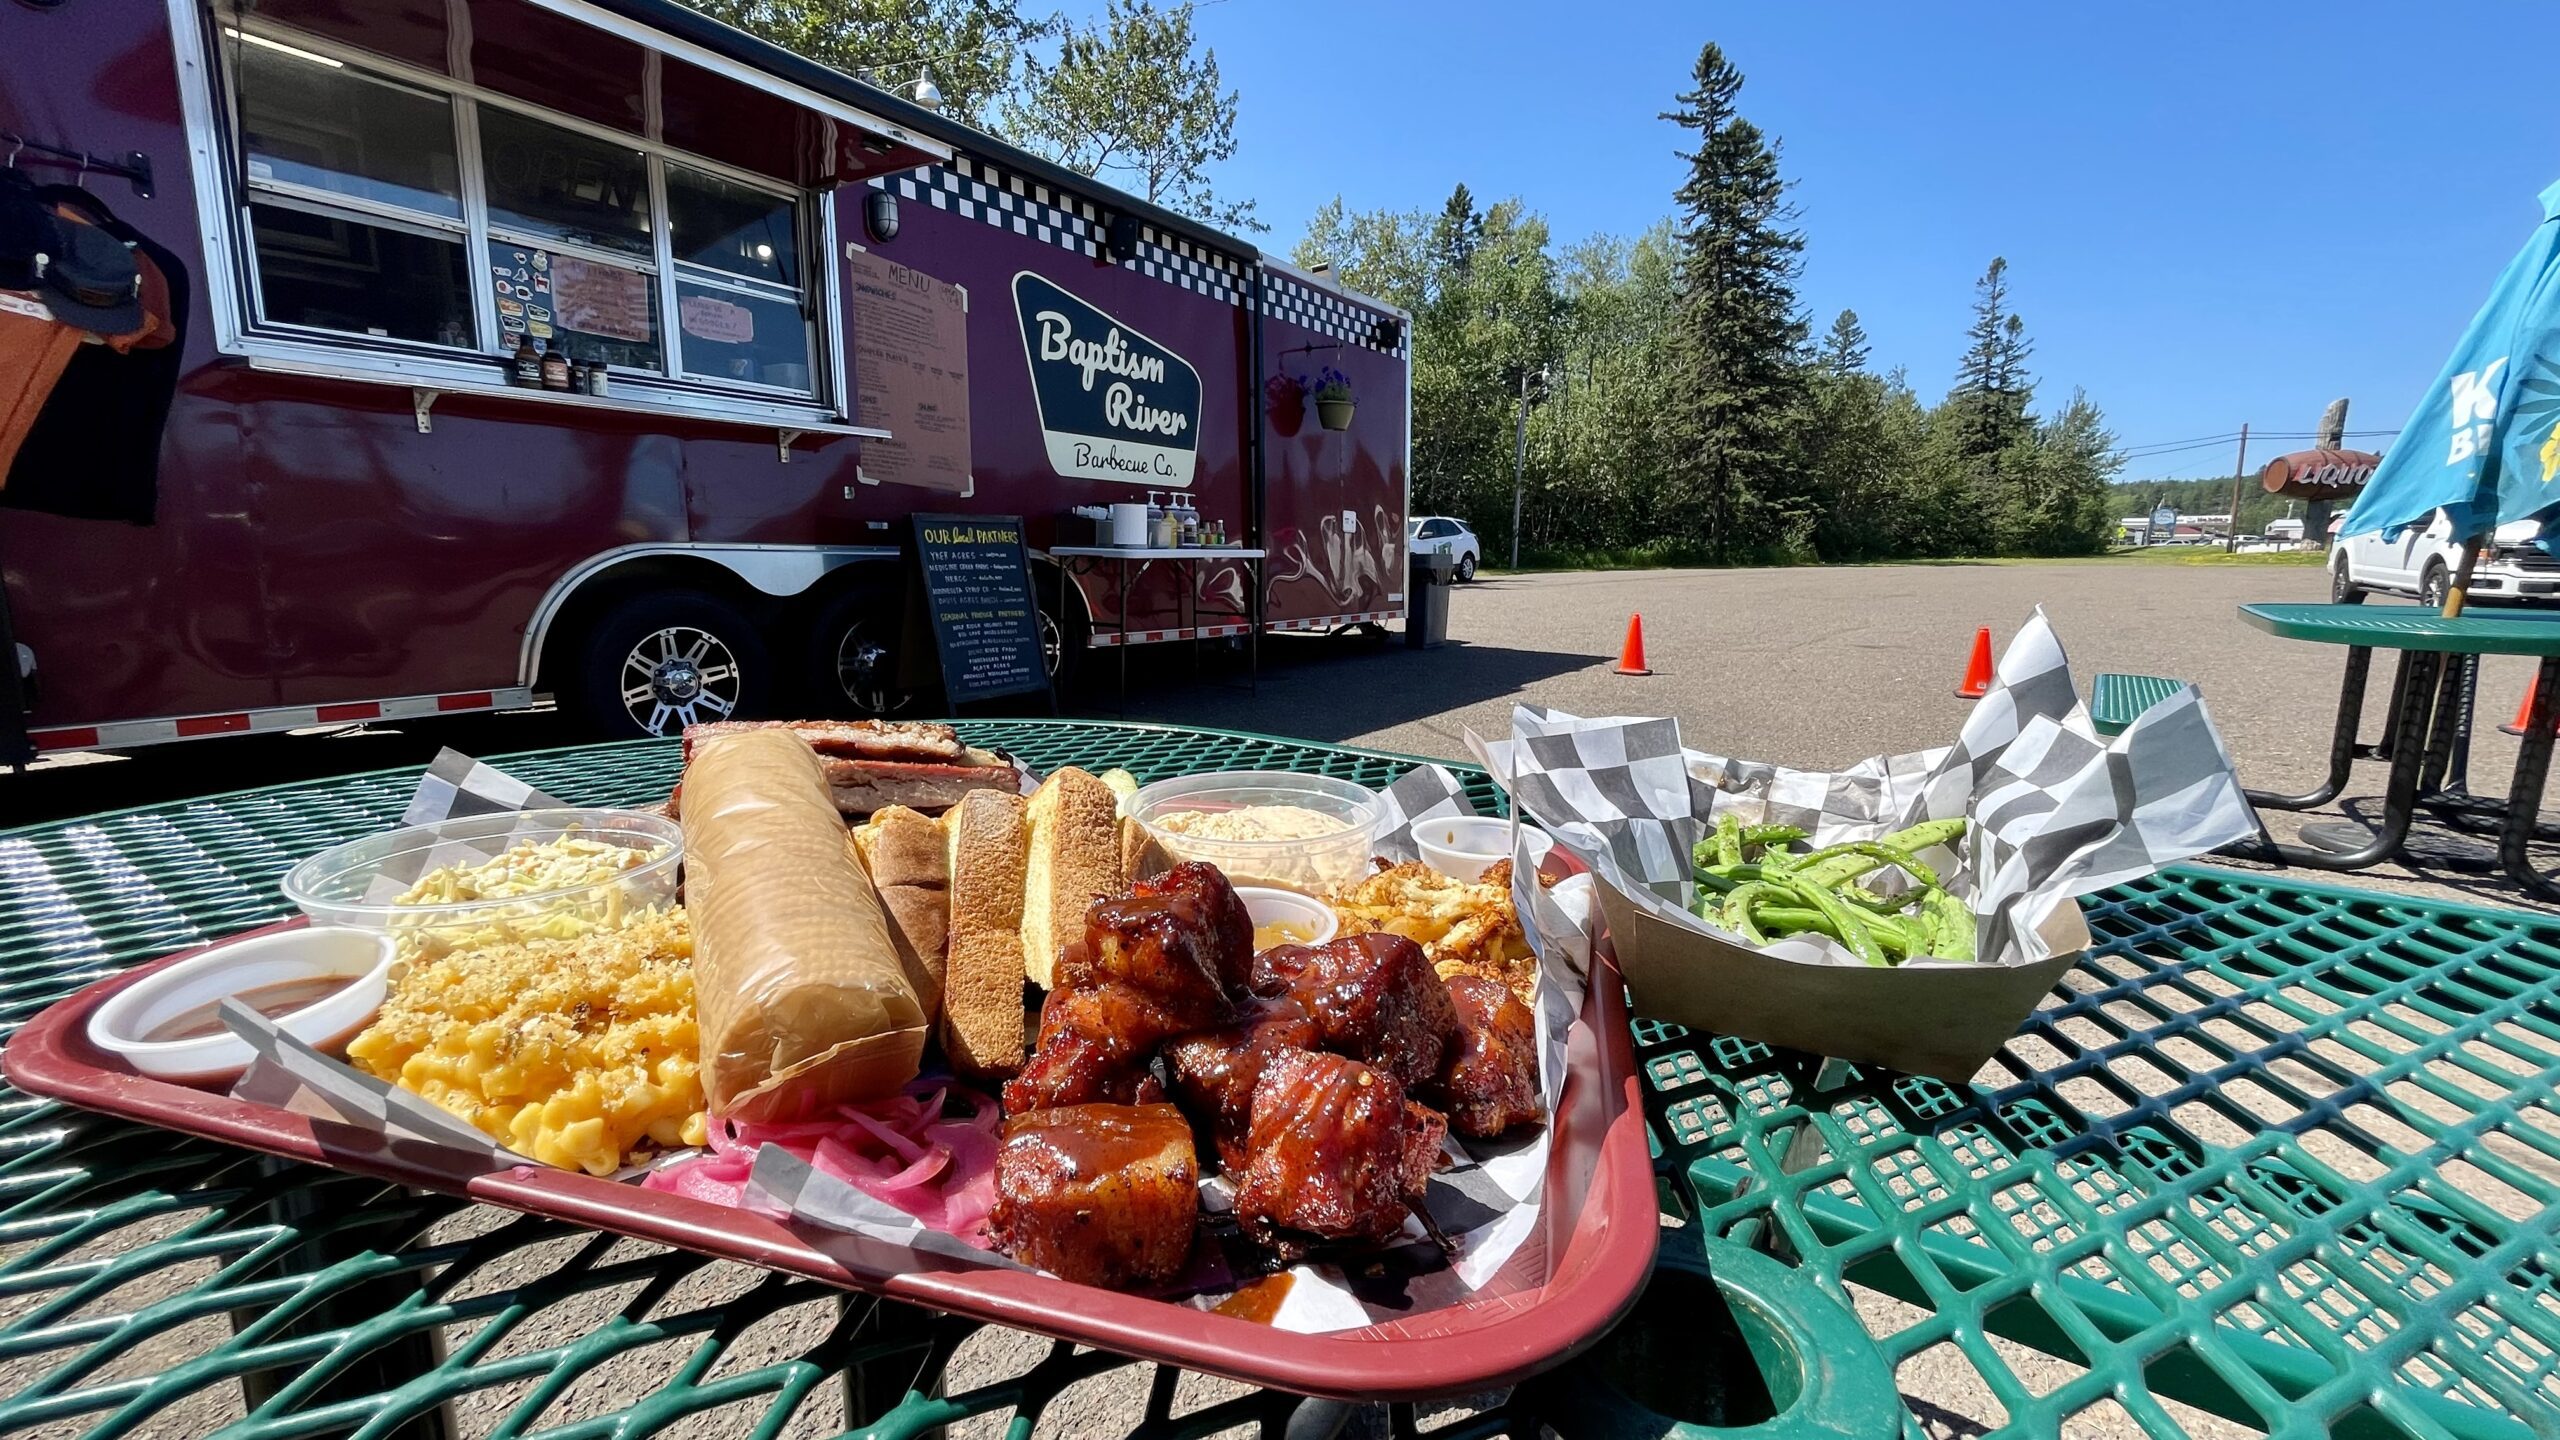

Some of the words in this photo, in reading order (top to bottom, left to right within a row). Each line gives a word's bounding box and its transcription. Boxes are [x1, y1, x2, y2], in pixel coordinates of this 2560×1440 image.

[888, 264, 931, 293] MENU
[1035, 310, 1164, 391] Baptism
[1105, 381, 1187, 436] River
[1074, 442, 1148, 474] Barbecue
[1154, 453, 1177, 477] Co.
[2295, 463, 2373, 489] LIQUO
[924, 528, 951, 545] OUR
[952, 526, 975, 544] local
[976, 529, 1019, 545] PARTNERS
